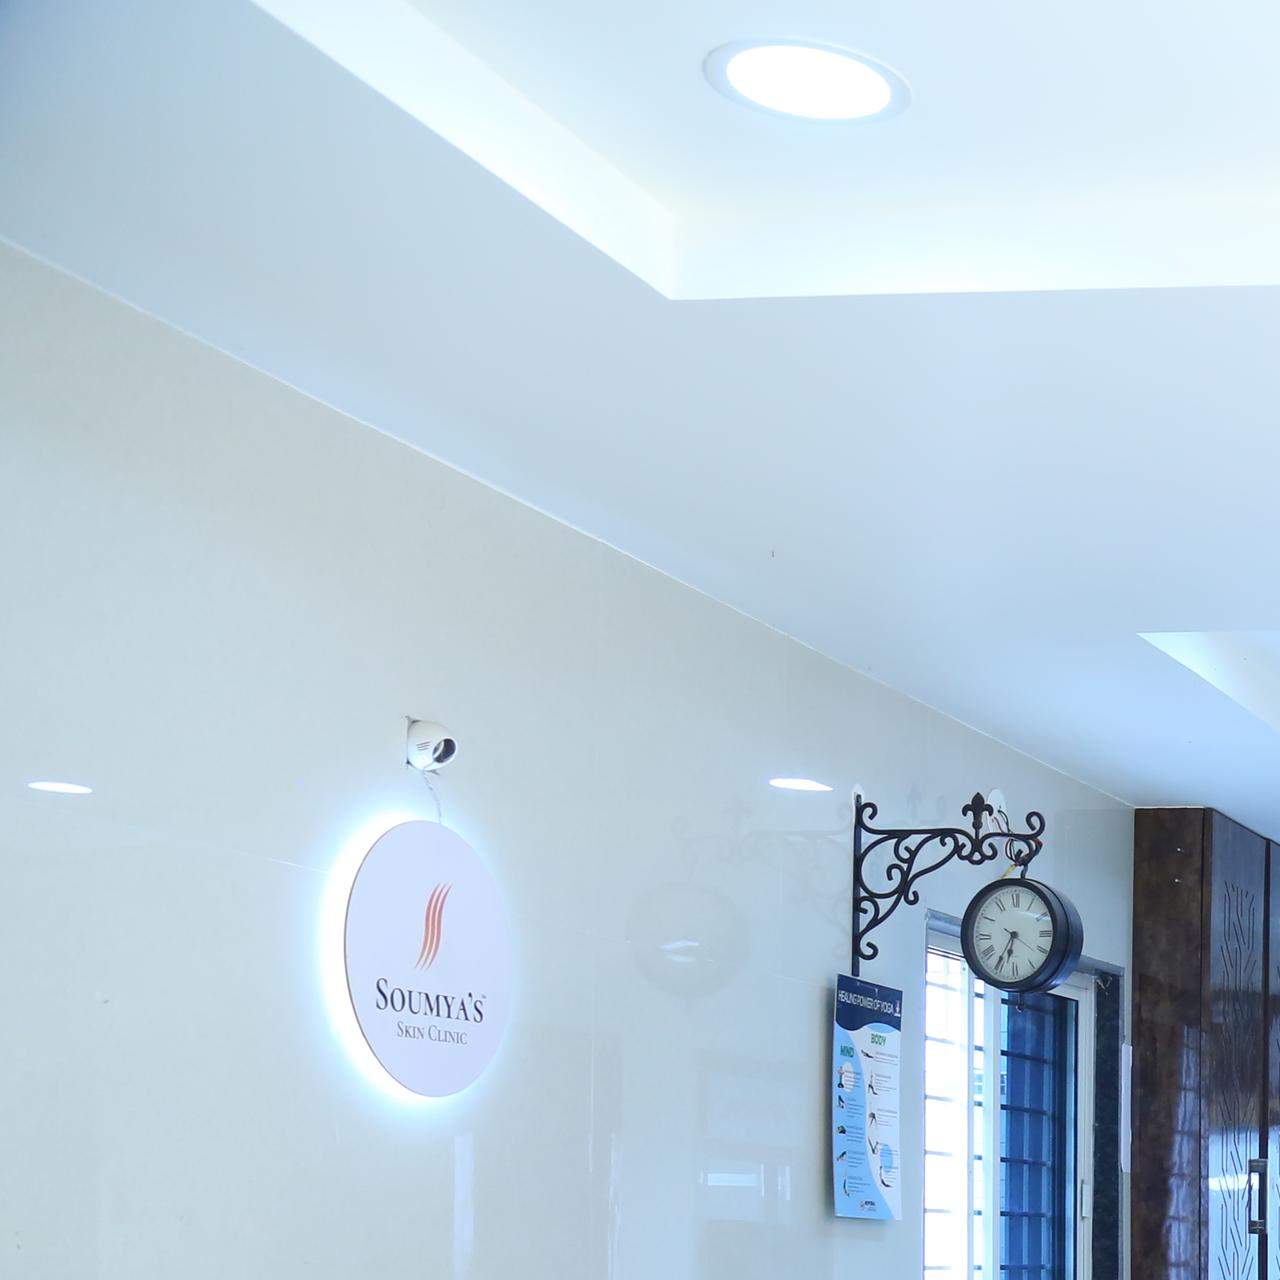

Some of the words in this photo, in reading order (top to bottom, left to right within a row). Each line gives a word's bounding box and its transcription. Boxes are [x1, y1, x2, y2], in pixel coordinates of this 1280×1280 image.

[376, 977, 484, 1023] SOUMYA'S
[396, 1020, 425, 1039] SKIN
[428, 1025, 468, 1045] CLINIC
